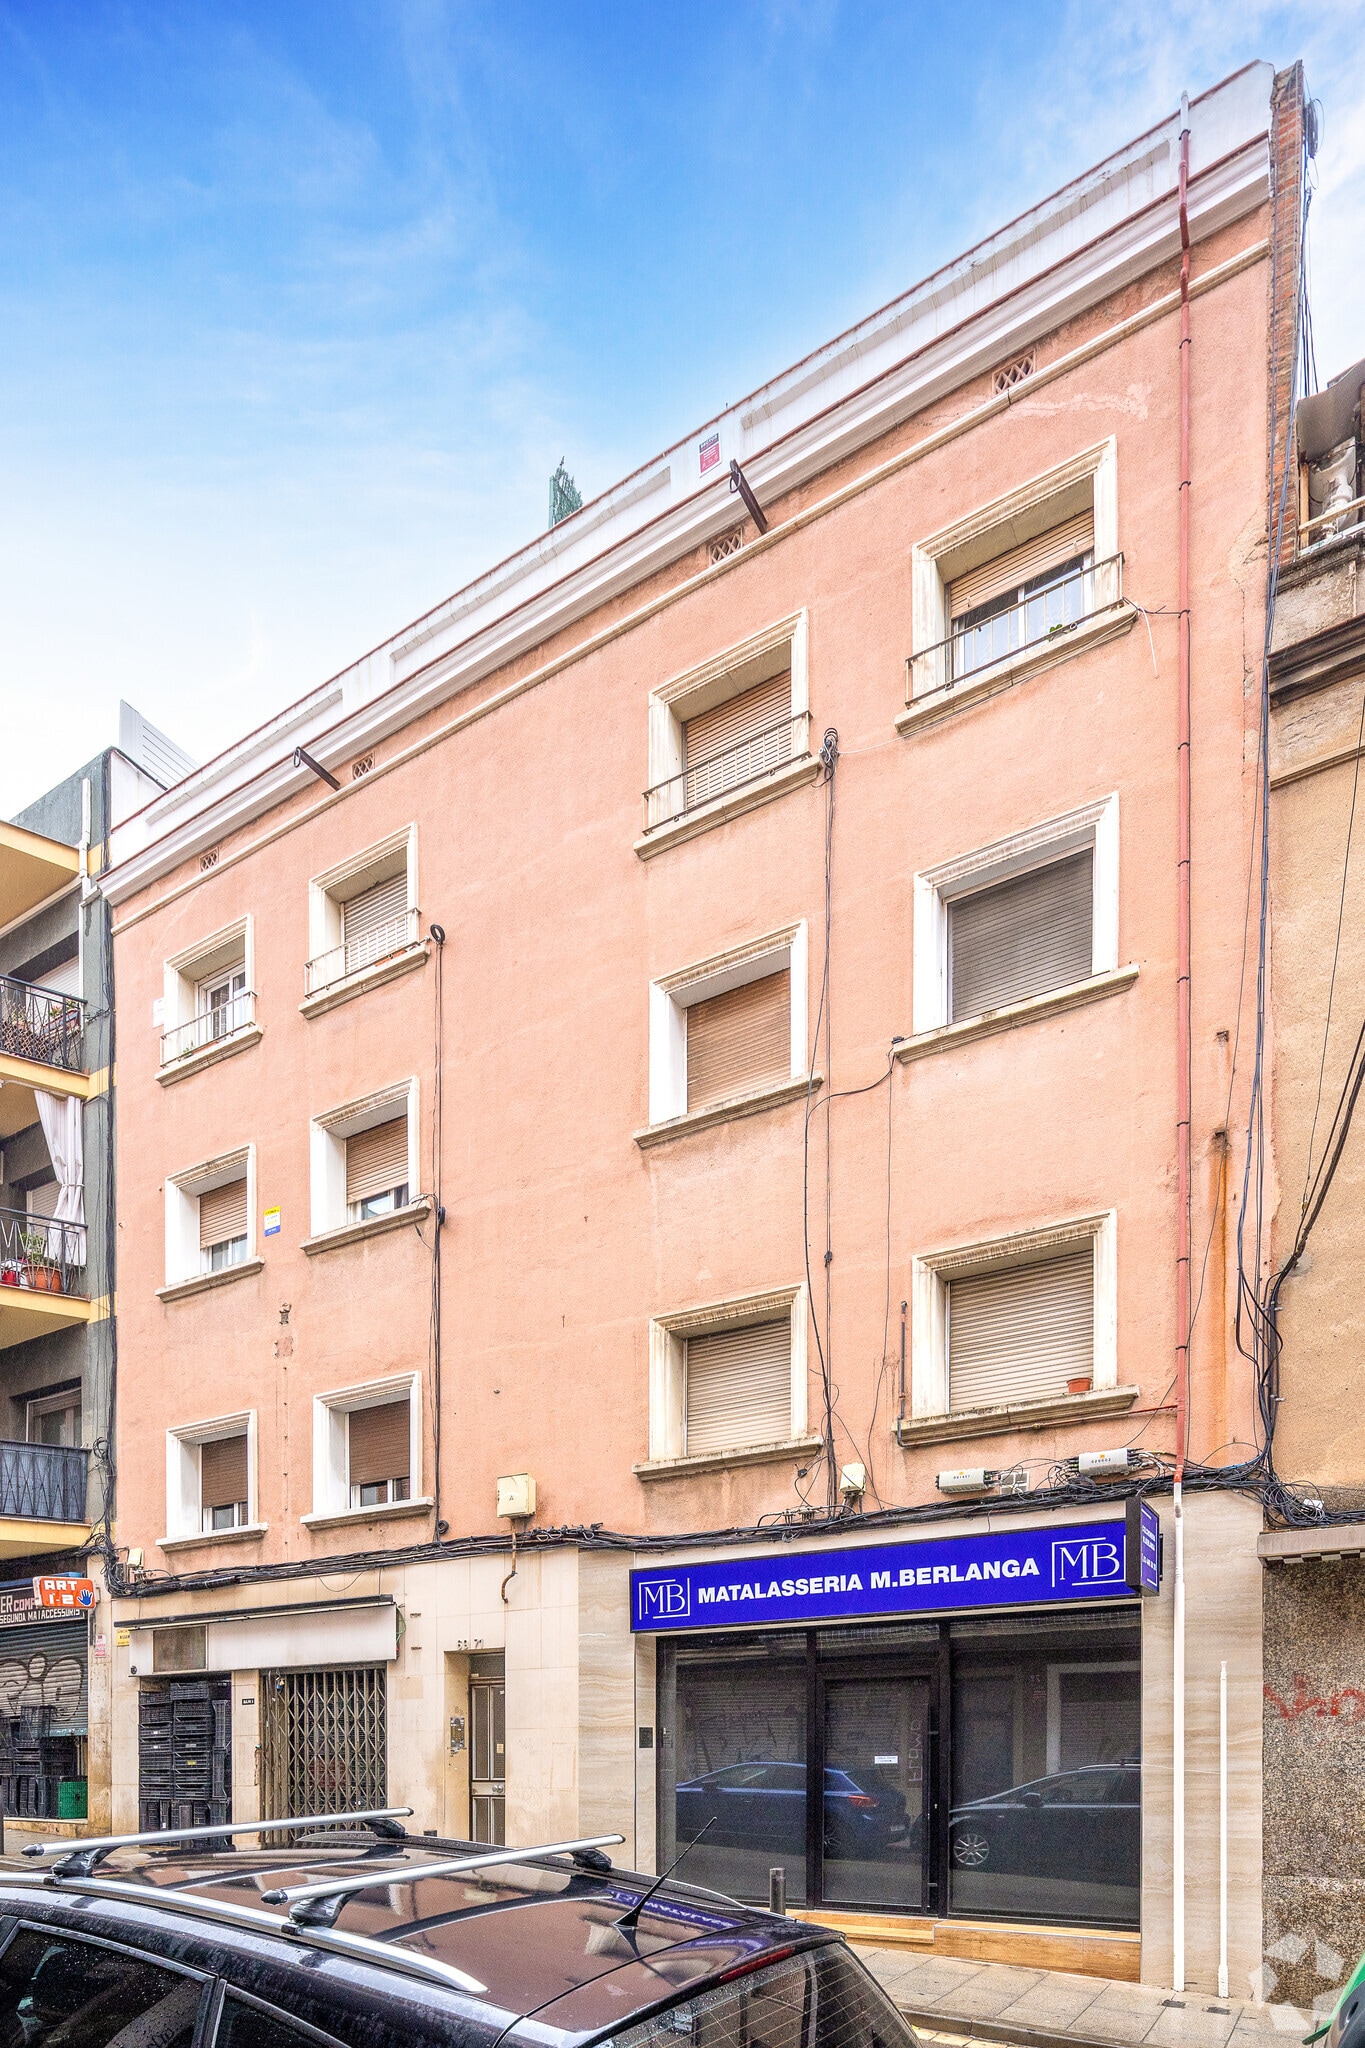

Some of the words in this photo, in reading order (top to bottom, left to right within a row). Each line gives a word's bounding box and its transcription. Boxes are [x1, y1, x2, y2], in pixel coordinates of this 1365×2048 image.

[44, 1580, 77, 1591] ART
[644, 1583, 686, 1615] MB
[698, 1573, 863, 1604] MATALASSERIA
[870, 1557, 1040, 1589] M.BERLANGA
[1059, 1542, 1121, 1581] MB
[14, 1597, 39, 1612] COMP
